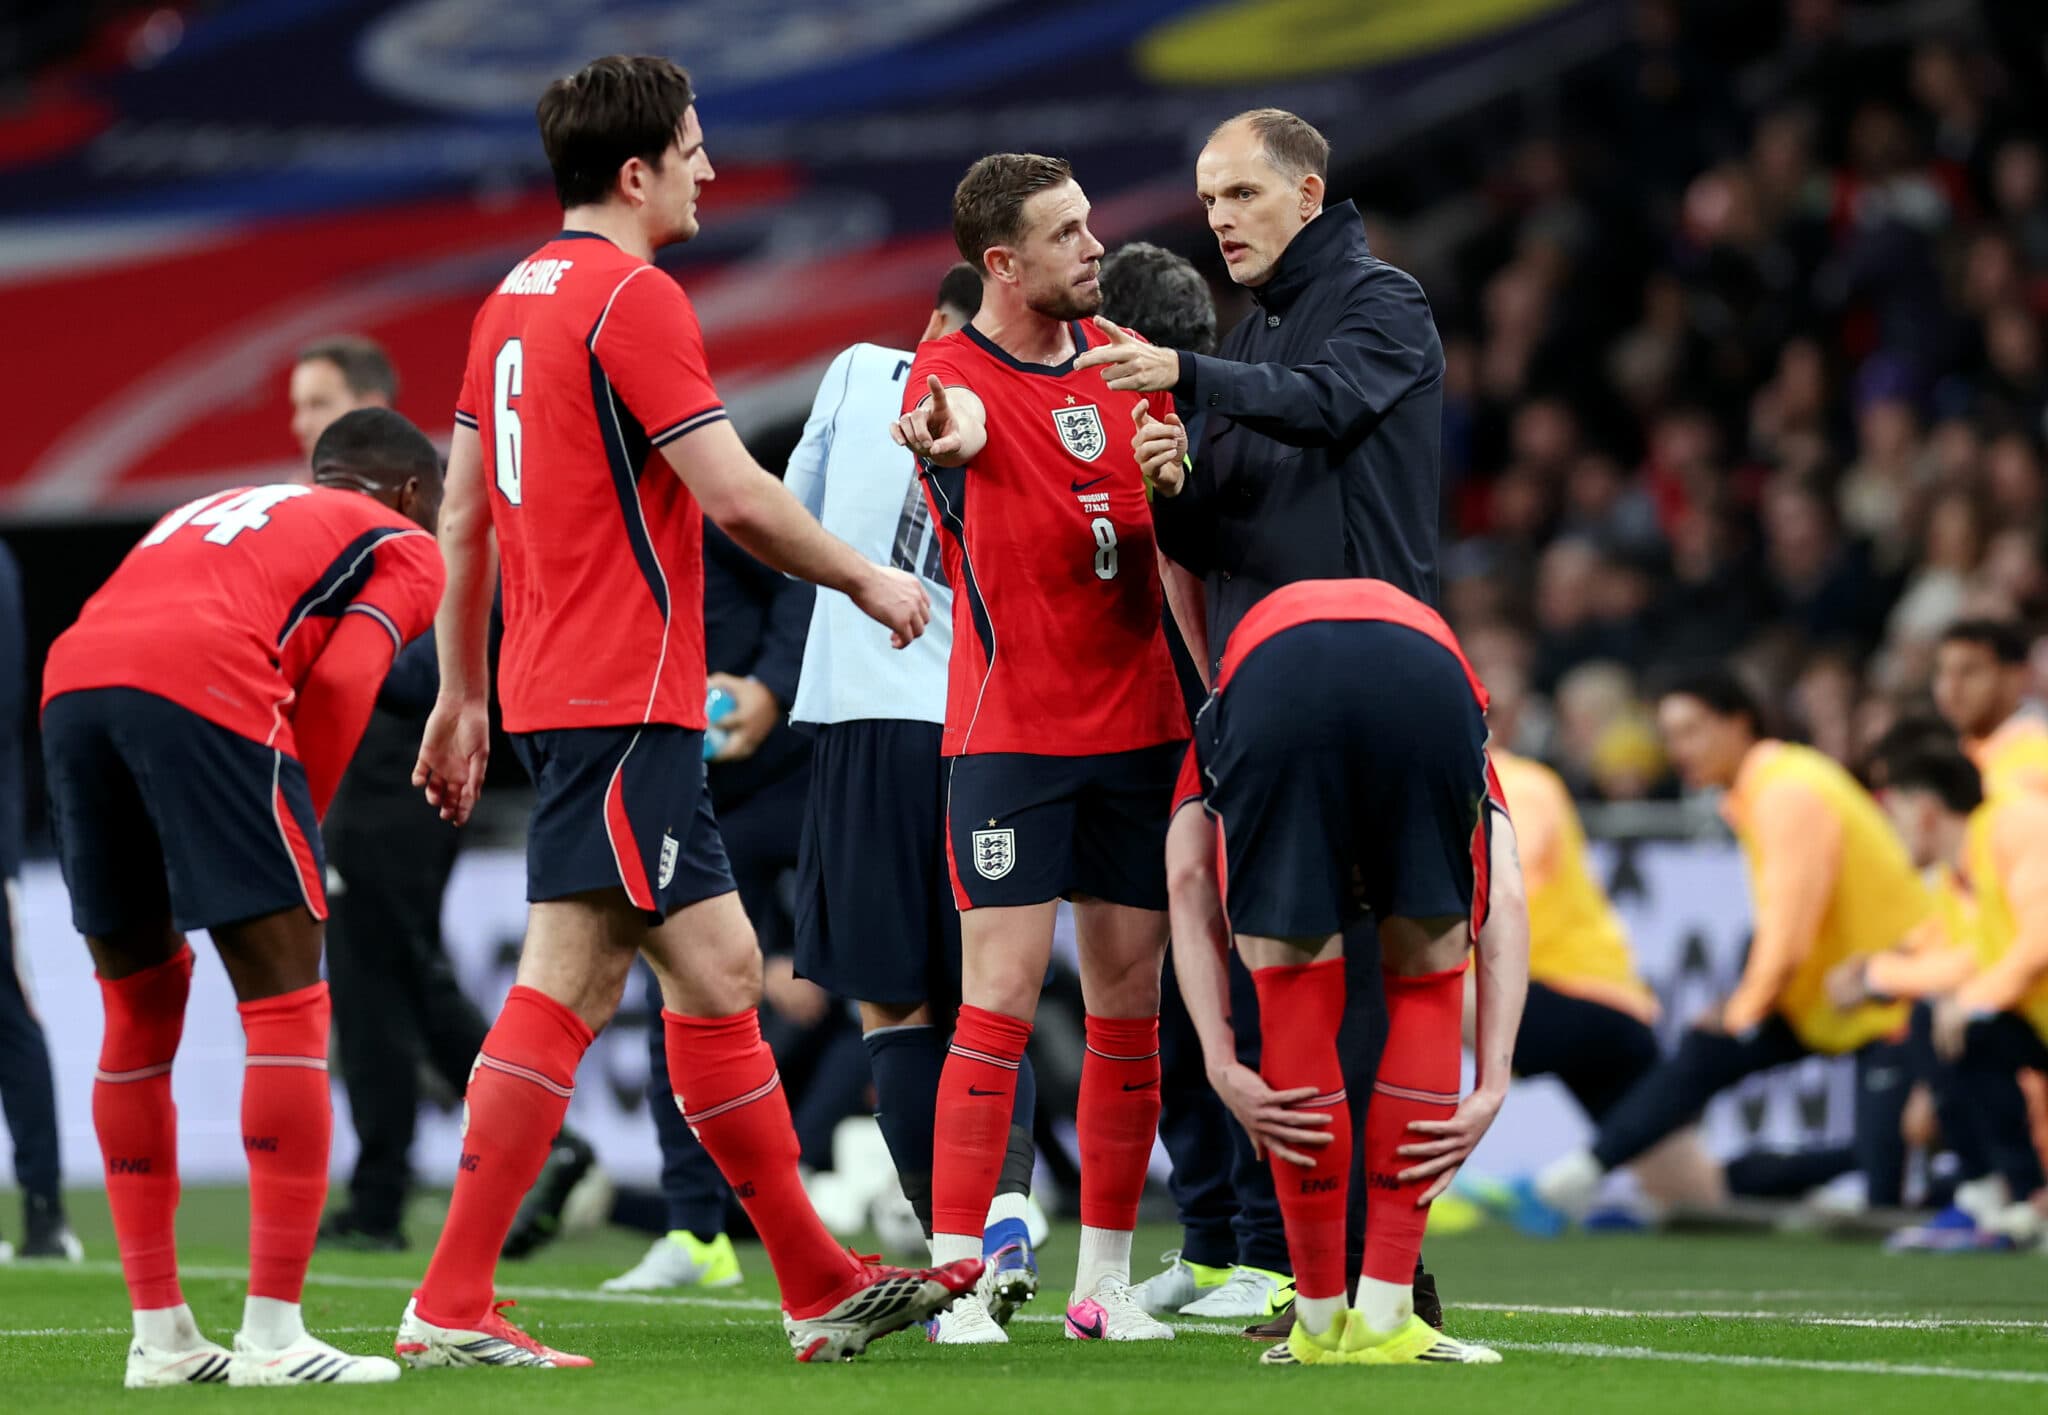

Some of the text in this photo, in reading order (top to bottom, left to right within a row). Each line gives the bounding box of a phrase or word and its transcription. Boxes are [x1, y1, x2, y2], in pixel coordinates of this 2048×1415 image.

[494, 336, 523, 507] 6
[139, 483, 313, 546] 14
[1090, 516, 1119, 580] 8
[110, 1157, 152, 1175] ENG
[1301, 1176, 1338, 1194] ENG
